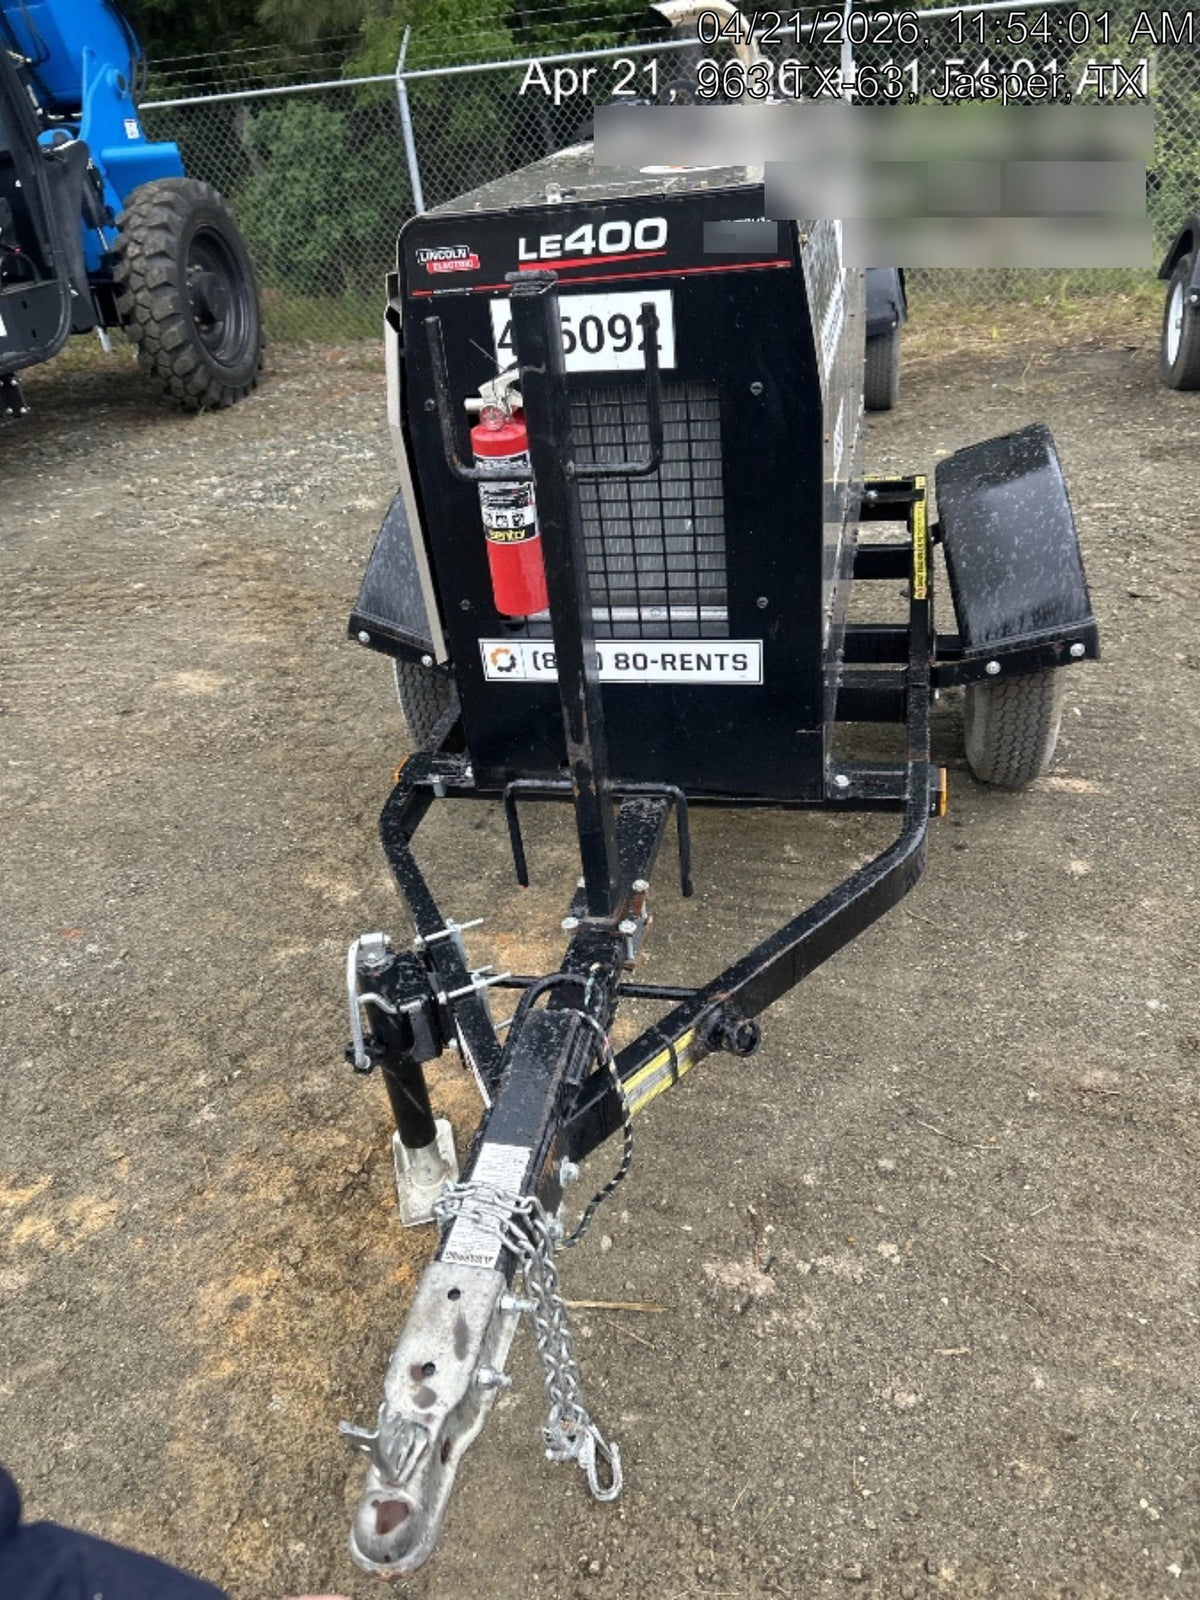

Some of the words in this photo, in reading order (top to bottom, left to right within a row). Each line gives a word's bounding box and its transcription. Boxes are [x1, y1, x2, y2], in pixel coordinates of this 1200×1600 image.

[518, 217, 667, 260] LE400
[420, 248, 467, 262] LINCOLN
[614, 653, 748, 671] 80-RENTS
